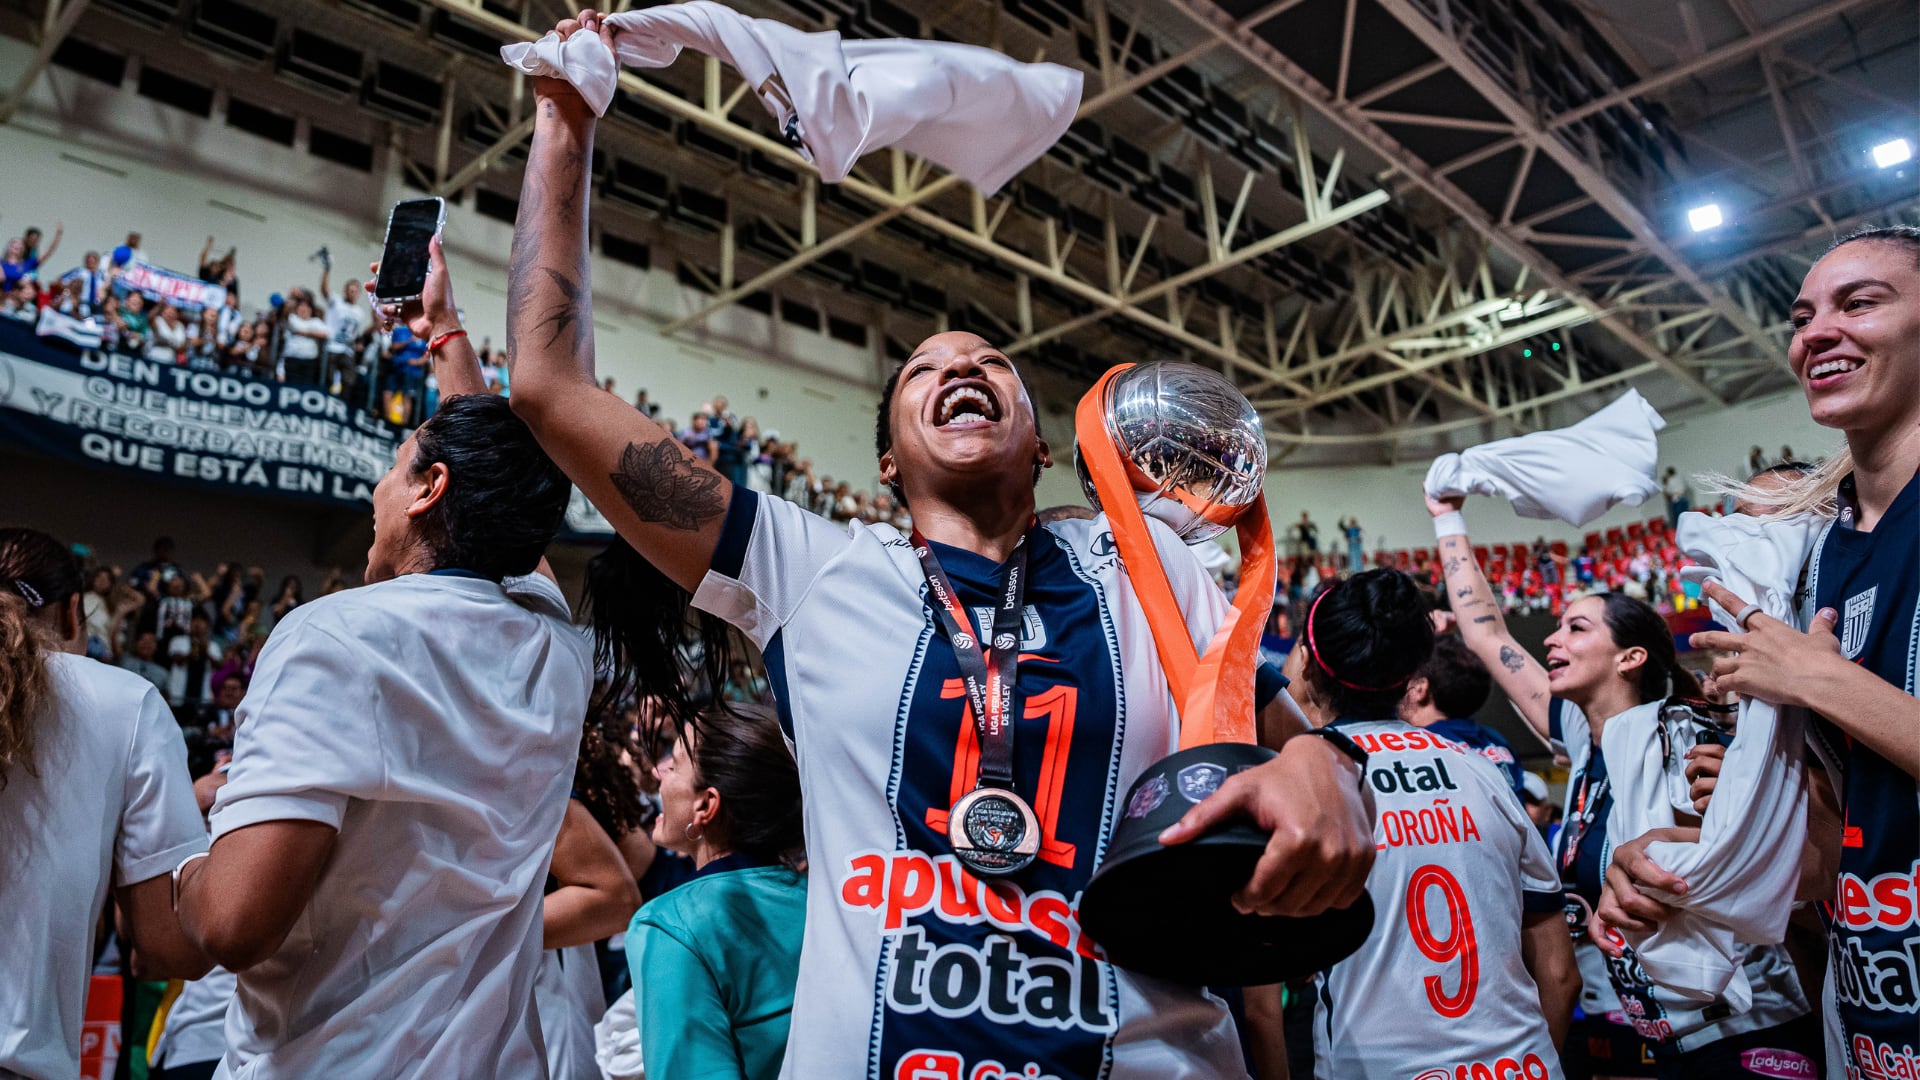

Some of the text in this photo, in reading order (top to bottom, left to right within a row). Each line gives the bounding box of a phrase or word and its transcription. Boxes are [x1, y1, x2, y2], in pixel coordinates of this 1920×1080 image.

[86, 376, 168, 413] QUE
[179, 396, 311, 436] LLEVAN
[169, 366, 271, 406] TODO
[278, 386, 348, 423] POR
[31, 385, 376, 481] Y RECORDAREMOS
[80, 433, 165, 473] QUE
[173, 452, 270, 488] ESTÁ
[277, 466, 325, 494] EN
[928, 574, 955, 611] betsson
[1003, 566, 1019, 610] betsson
[967, 675, 984, 715] PERUANA
[990, 675, 1001, 736] LIGA PERUANA
[1001, 713, 1010, 726] DE
[1371, 757, 1458, 794] otal
[1376, 798, 1481, 850] OROÑA
[1406, 864, 1480, 1018] 9
[889, 930, 1112, 1028] total
[1749, 1052, 1811, 1074] Ladysoft
